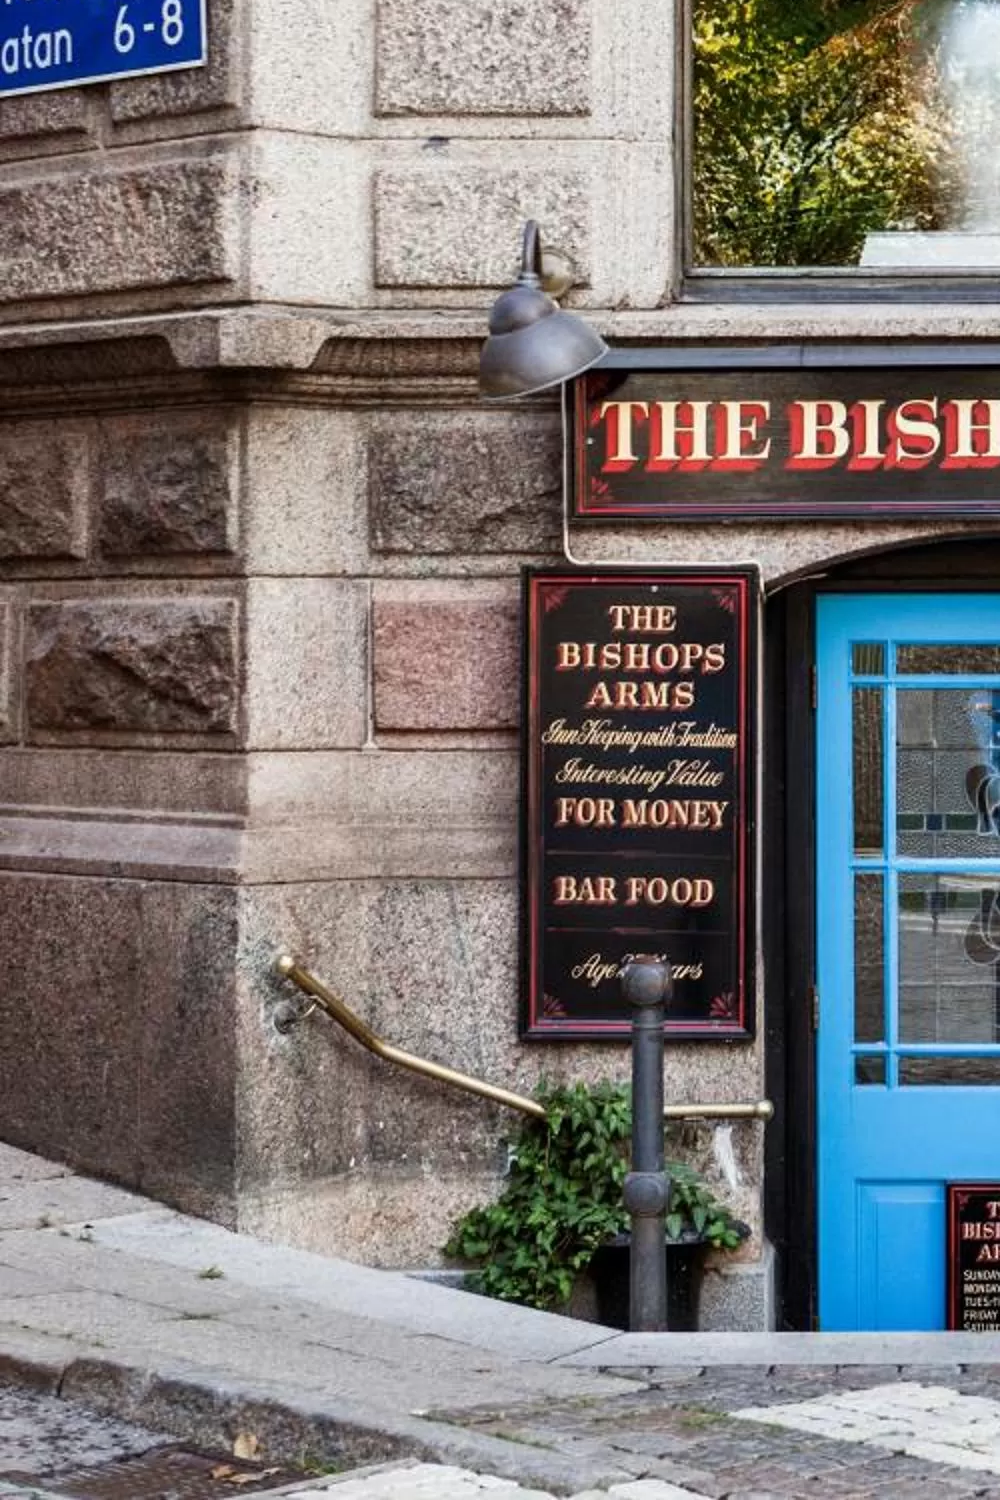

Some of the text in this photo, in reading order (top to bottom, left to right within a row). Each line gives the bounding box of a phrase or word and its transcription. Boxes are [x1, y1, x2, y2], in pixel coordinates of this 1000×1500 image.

[599, 400, 771, 462] THE
[608, 604, 678, 632] THE
[556, 641, 726, 672] BISHOPS
[586, 680, 696, 708] ARMS
[541, 717, 579, 745] Inn
[642, 721, 676, 747] with
[675, 721, 738, 748] Tradition
[555, 756, 725, 793] Interesting Value
[558, 797, 729, 829] FOR MONEY
[556, 876, 714, 904] BAR FOOD
[571, 953, 618, 988] Age
[963, 1310, 999, 1320] FRIDAY
